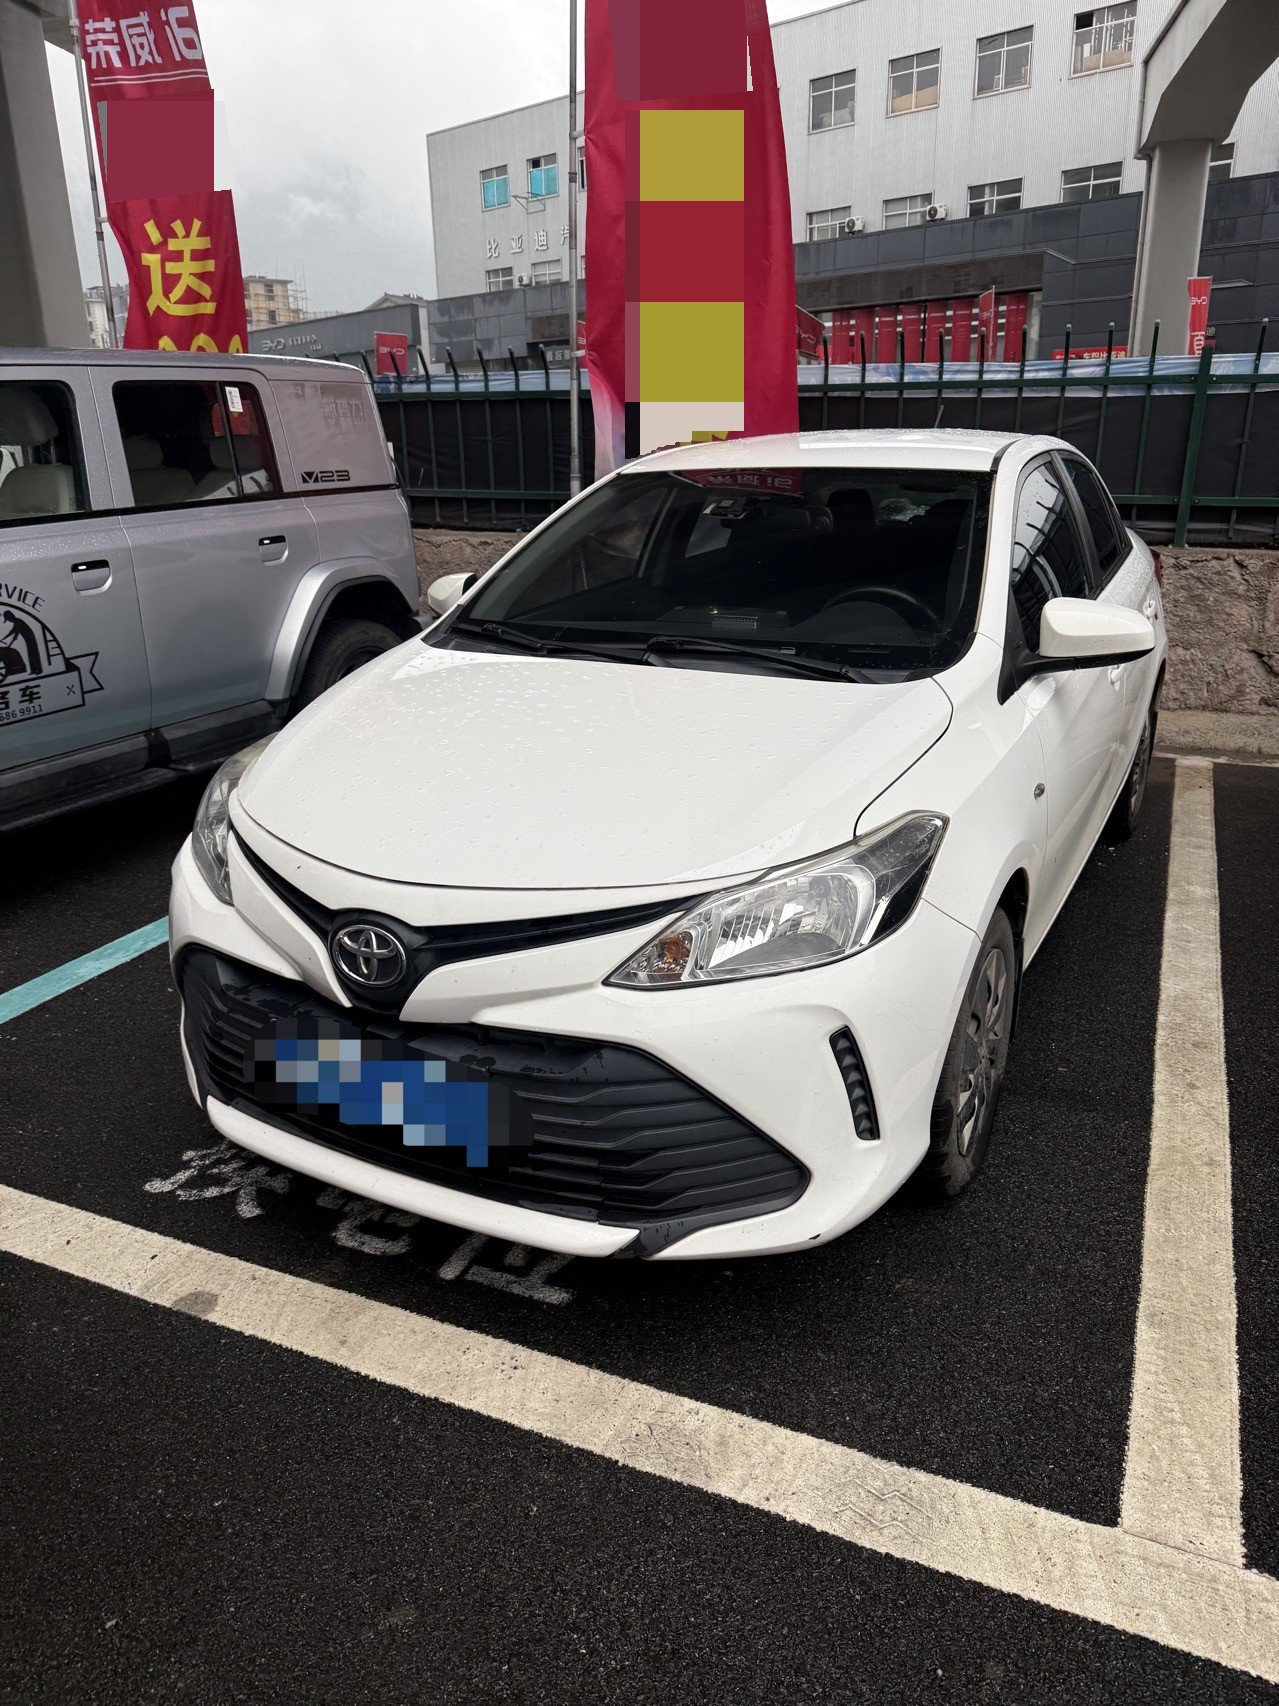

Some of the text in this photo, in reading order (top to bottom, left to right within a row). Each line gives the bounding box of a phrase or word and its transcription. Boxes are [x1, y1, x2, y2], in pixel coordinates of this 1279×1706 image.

[85, 11, 162, 69] 荣威
[141, 218, 216, 317] 送
[1191, 296, 1208, 305] BYD
[262, 338, 285, 351] BYD
[301, 470, 350, 483] V23
[19, 704, 43, 717] 9911
